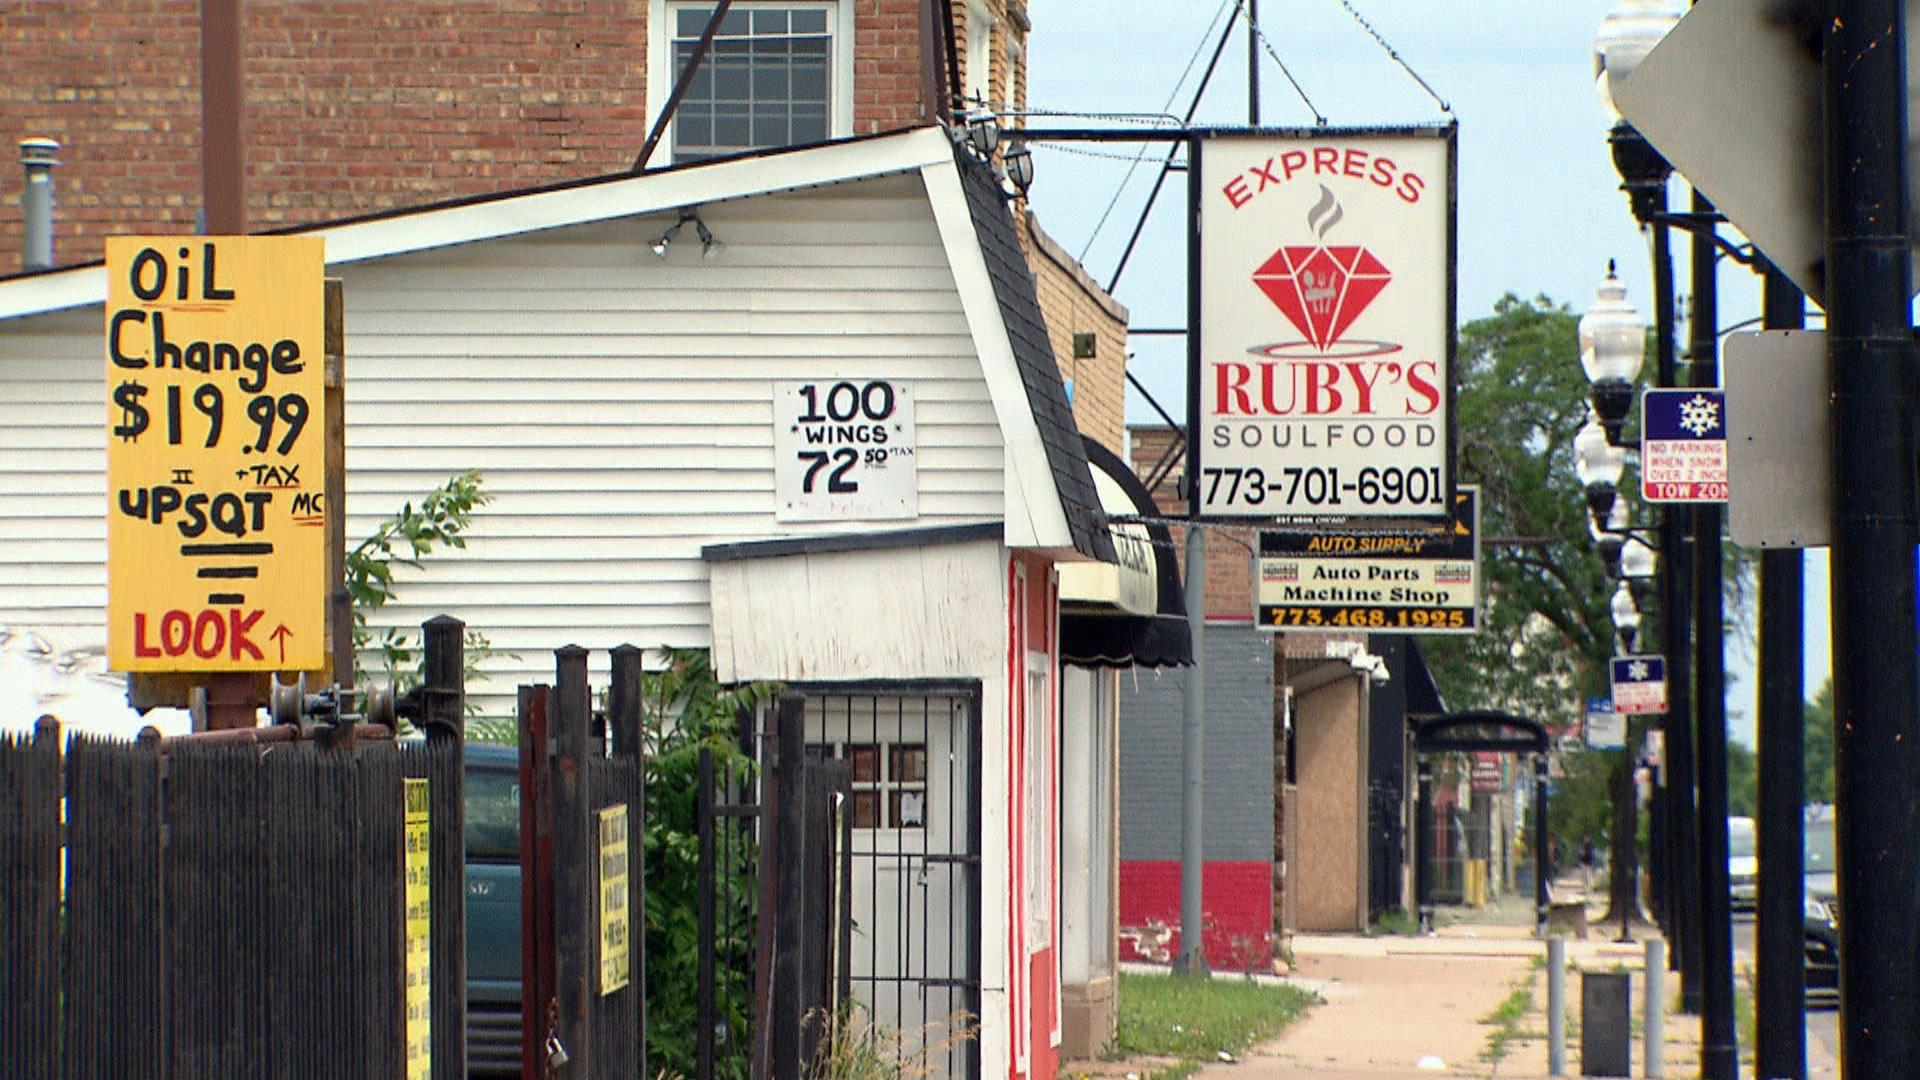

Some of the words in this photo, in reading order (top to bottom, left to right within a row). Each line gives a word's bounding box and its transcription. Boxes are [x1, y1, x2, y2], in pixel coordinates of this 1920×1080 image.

[1222, 147, 1426, 210] EXPRESS
[109, 309, 304, 393] Change
[797, 381, 895, 423] 100
[1211, 361, 1440, 416] RUBY'S
[805, 425, 888, 445] WINGS
[1213, 424, 1436, 448] SOULFOOD
[797, 447, 859, 494] 72
[864, 447, 888, 464] 50
[1203, 466, 1443, 506] 773-701-6901
[1656, 483, 1690, 498] TOW
[1308, 536, 1356, 552] AUTO
[1359, 536, 1425, 554] SUPPLY
[1313, 565, 1361, 580] Auto
[1368, 565, 1420, 580] Parts
[1284, 586, 1383, 602] Machine
[1389, 587, 1450, 606] Shop
[1271, 607, 1465, 628] 773.468.1925
[134, 609, 265, 662] LOOK
